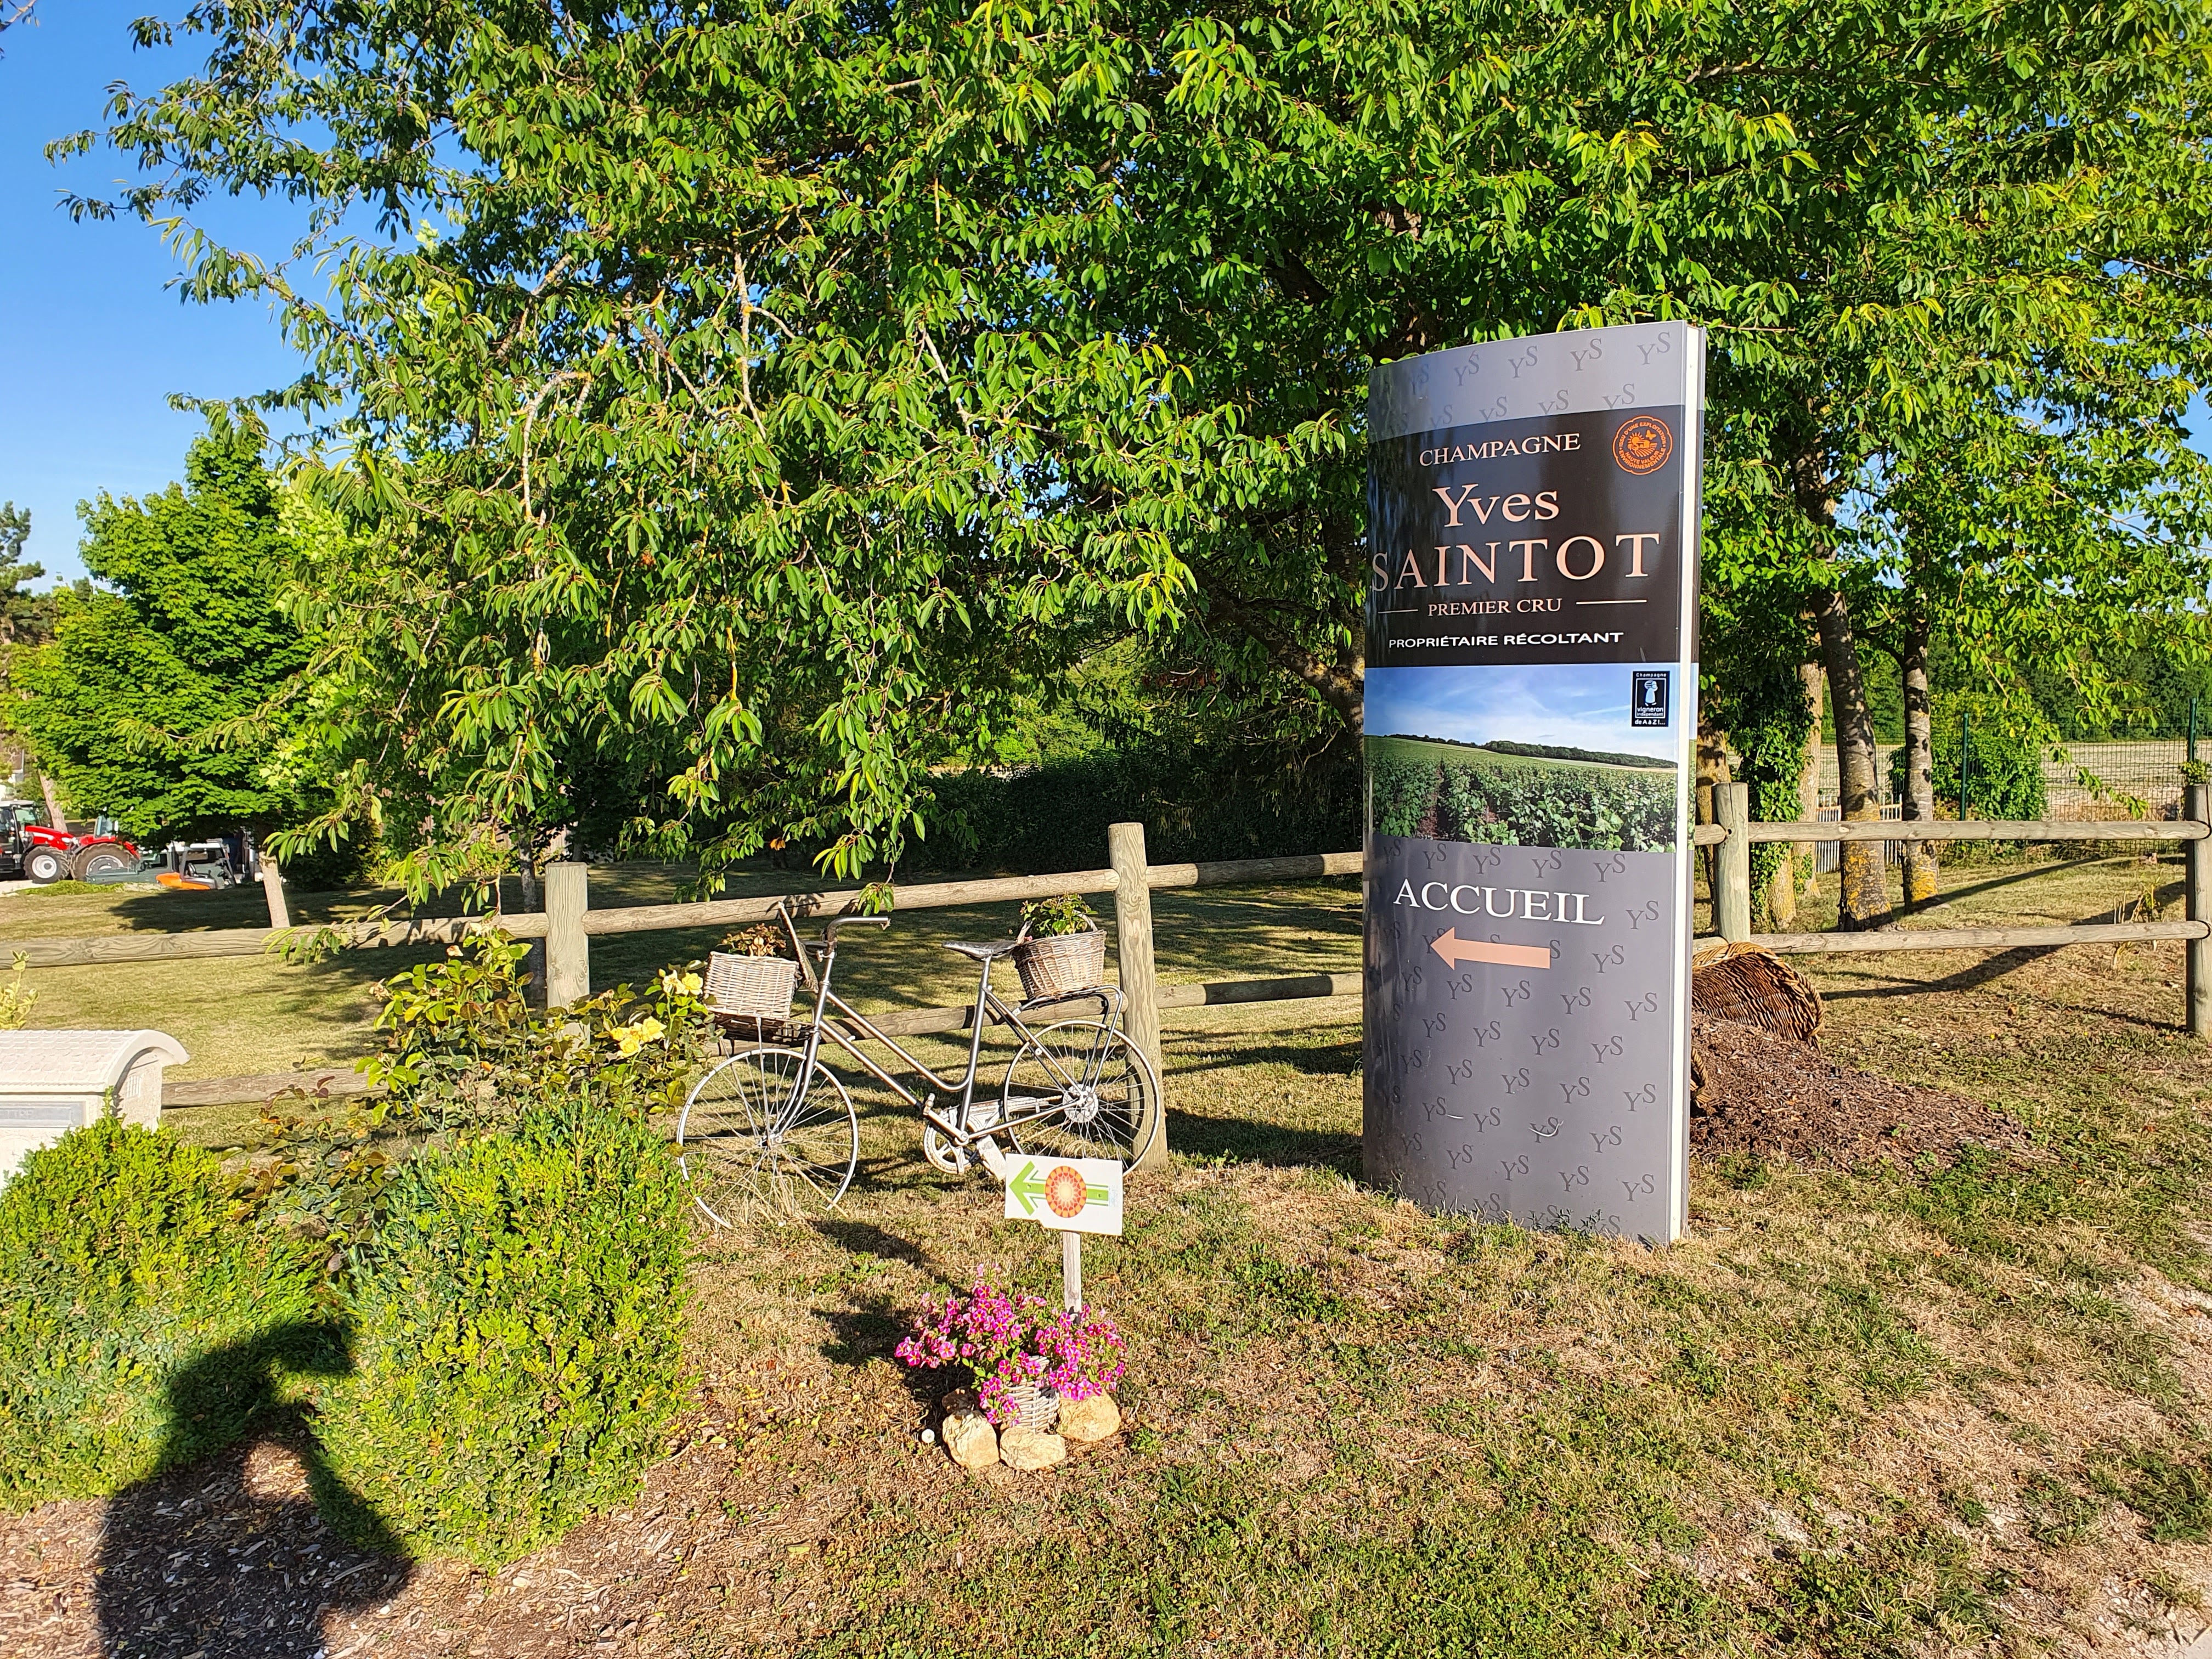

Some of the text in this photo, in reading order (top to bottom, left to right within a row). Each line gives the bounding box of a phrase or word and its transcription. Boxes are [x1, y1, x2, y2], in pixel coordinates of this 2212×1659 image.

[1639, 422, 1667, 444] EXPLOITATION
[1419, 433, 1581, 467] CHAMPAGNE
[1625, 452, 1640, 464] HAUTE
[1432, 483, 1560, 527] Yves
[1370, 533, 1660, 591] SAINTOT
[1427, 598, 1563, 617] PREMIER CRU
[1389, 631, 1624, 648] PROPRIÉTAIRE RÉCOLTANT
[1393, 878, 1605, 925] ACCUEIL
